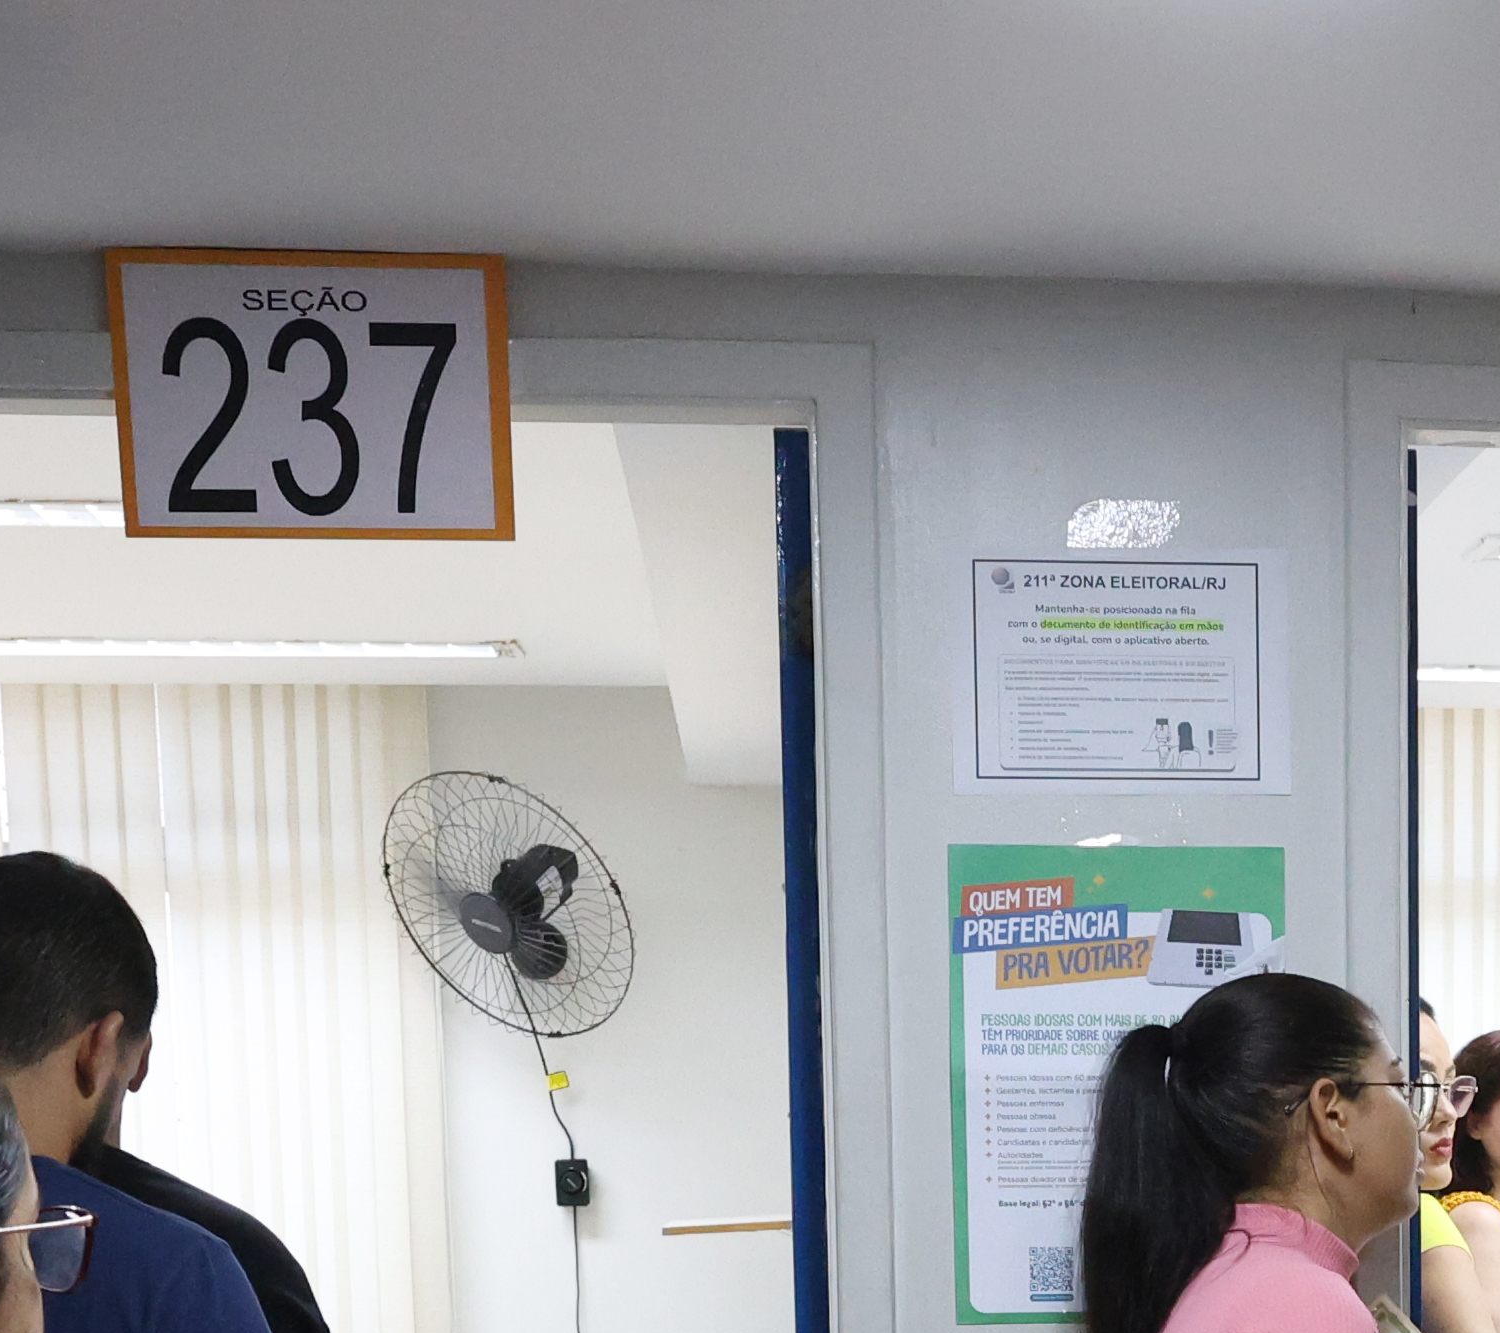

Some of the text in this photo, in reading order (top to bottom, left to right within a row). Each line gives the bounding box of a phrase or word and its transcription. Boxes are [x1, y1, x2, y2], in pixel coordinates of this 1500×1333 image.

[242, 286, 368, 316] SEÇÃO
[162, 316, 457, 517] 237
[1023, 574, 1226, 590] 211ª ZONA ELEITORAL/RJ
[1035, 604, 1196, 616] Mantenha-se posicionado na fila
[1040, 619, 1096, 629] documento
[1099, 619, 1111, 629] de
[1113, 620, 1176, 632] identificação
[1197, 621, 1224, 631] mãos
[1091, 637, 1112, 645] com
[1124, 635, 1172, 646] aplicativo
[969, 885, 1062, 916] QUEM TEM
[963, 909, 1120, 948] PREFERÊNCIA
[1003, 939, 1150, 982] PRA VOTAR?
[981, 1013, 1030, 1027] PESSOAS
[1034, 1013, 1074, 1027] IDOSAS
[1077, 1013, 1102, 1027] COM
[1105, 1013, 1132, 1027] MAIS
[1135, 1013, 1148, 1027] DE
[982, 1028, 1003, 1041] TÊM
[1005, 1029, 1063, 1042] PRIORIDADE
[1066, 1029, 1100, 1042] SOBRE
[981, 1043, 1008, 1056] PARA
[1011, 1043, 1025, 1056] OS
[1028, 1042, 1068, 1056] DEMAIS
[996, 1074, 1027, 1082] Pessoas
